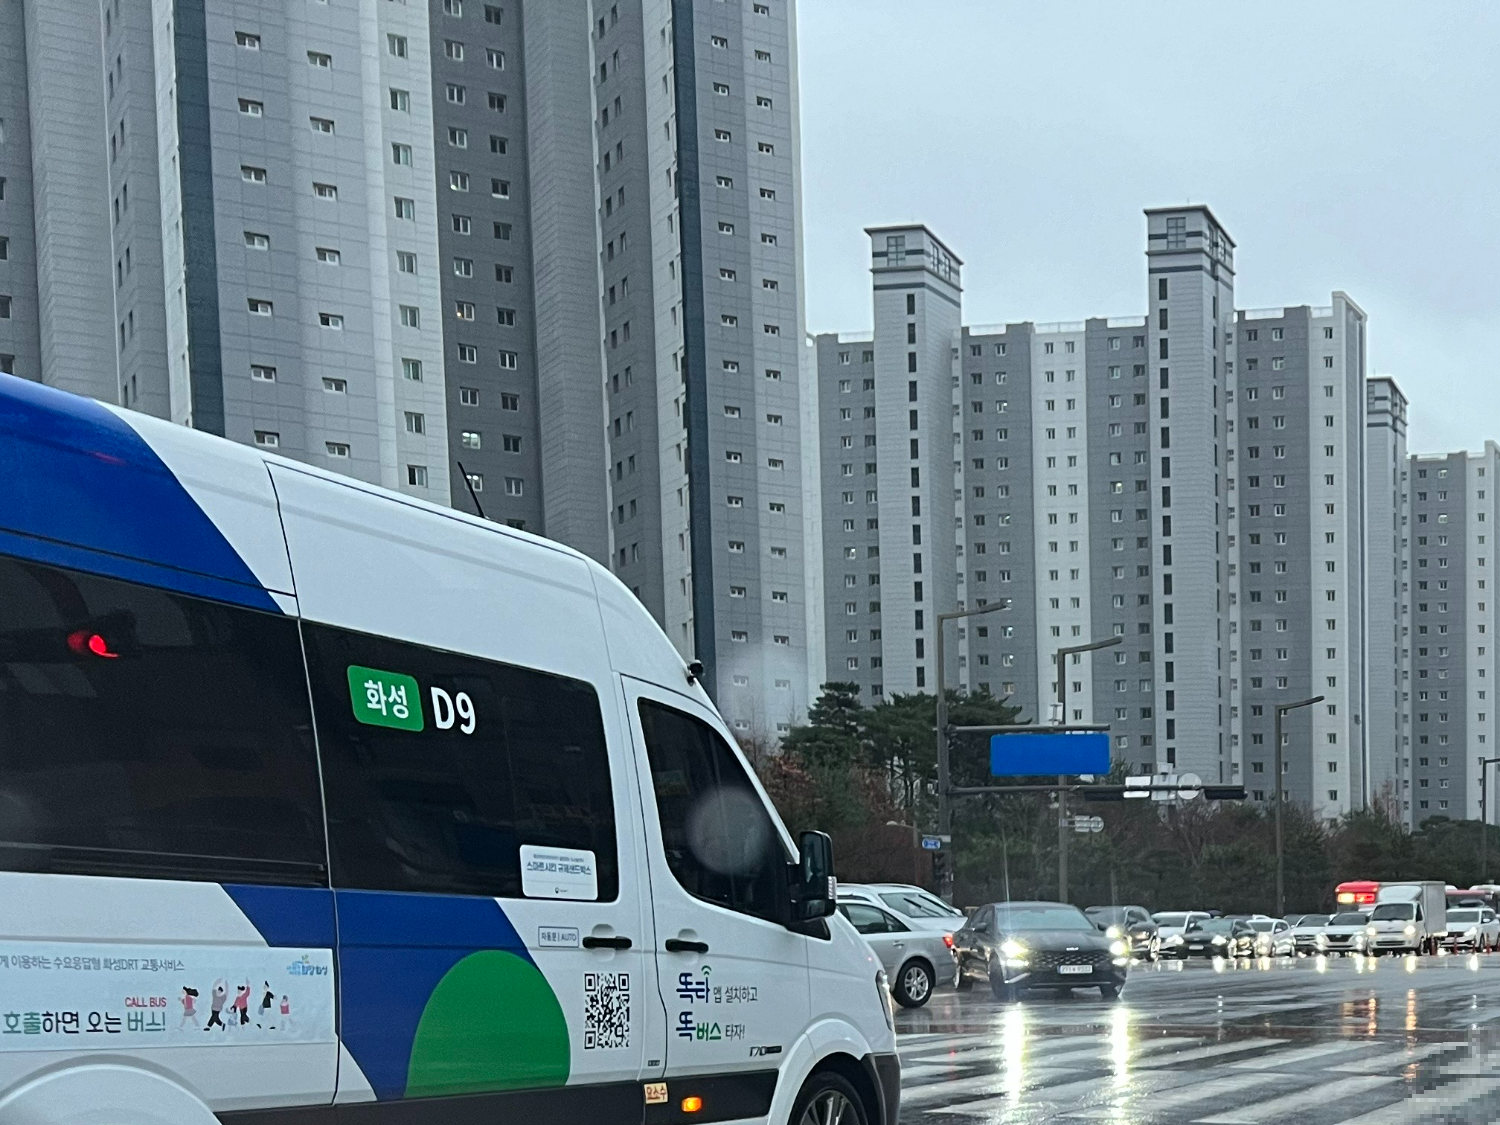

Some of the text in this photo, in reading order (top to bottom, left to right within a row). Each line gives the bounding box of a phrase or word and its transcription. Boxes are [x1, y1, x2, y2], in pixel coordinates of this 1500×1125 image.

[364, 680, 476, 735] 화성 D9
[561, 933, 577, 942] AUTO
[11, 955, 51, 969] 이용하는
[53, 956, 101, 970] 수요응답형
[103, 957, 139, 971] 화성DRT
[141, 958, 185, 972] 교통서비스
[125, 997, 167, 1007] CALL BUS
[713, 987, 722, 1003] 앱
[724, 986, 758, 1003] 설치하고
[2, 1011, 166, 1035] 호출하면 오는 버스!
[676, 1011, 745, 1042] 똑버스 타자!
